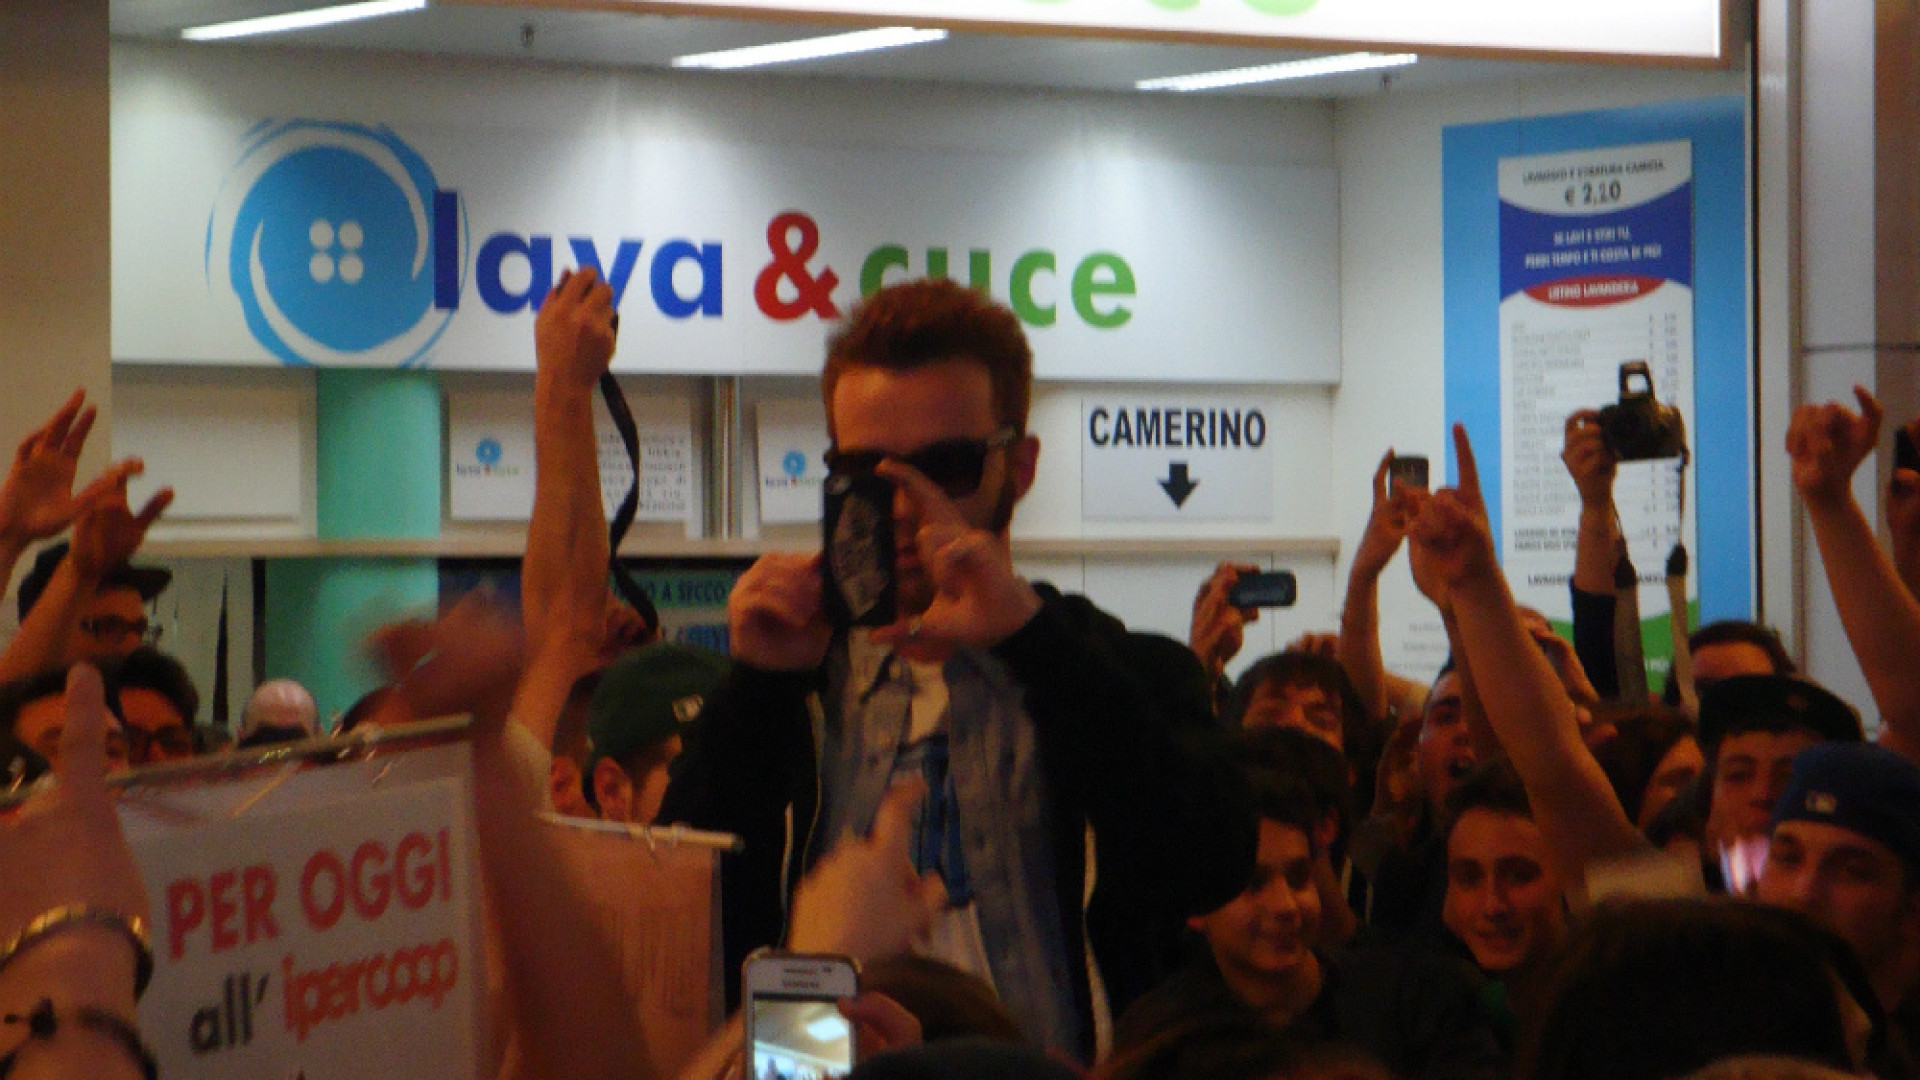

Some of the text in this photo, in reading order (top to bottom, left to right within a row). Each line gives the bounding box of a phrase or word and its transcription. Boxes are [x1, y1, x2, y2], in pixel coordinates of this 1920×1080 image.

[433, 190, 723, 320] lava
[754, 209, 843, 324] &
[1090, 406, 1267, 449] CAMERINO
[166, 828, 452, 960] PER OGGI
[281, 938, 458, 1040] ipercoop
